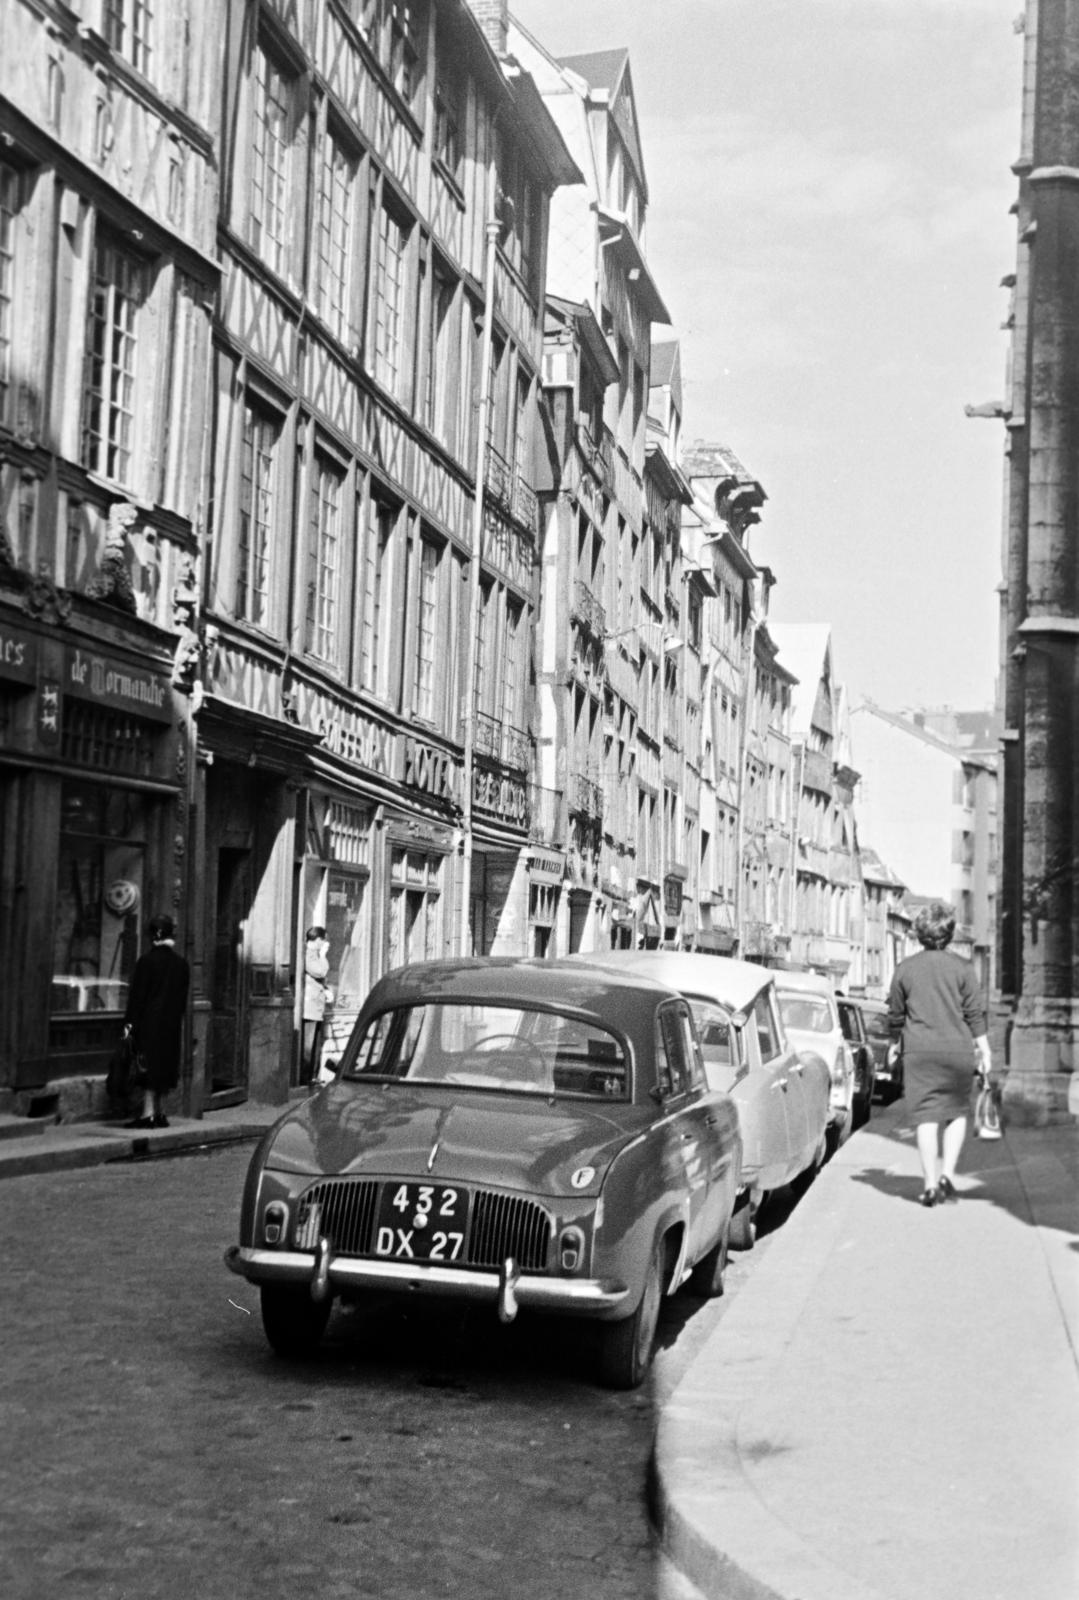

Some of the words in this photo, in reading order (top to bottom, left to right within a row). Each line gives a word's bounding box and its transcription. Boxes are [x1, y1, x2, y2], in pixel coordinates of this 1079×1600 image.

[71, 649, 88, 684] de
[90, 655, 166, 708] Normandie
[576, 1169, 590, 1184] F
[392, 1184, 458, 1217] 432
[376, 1227, 415, 1258] DX
[429, 1231, 464, 1260] 27
